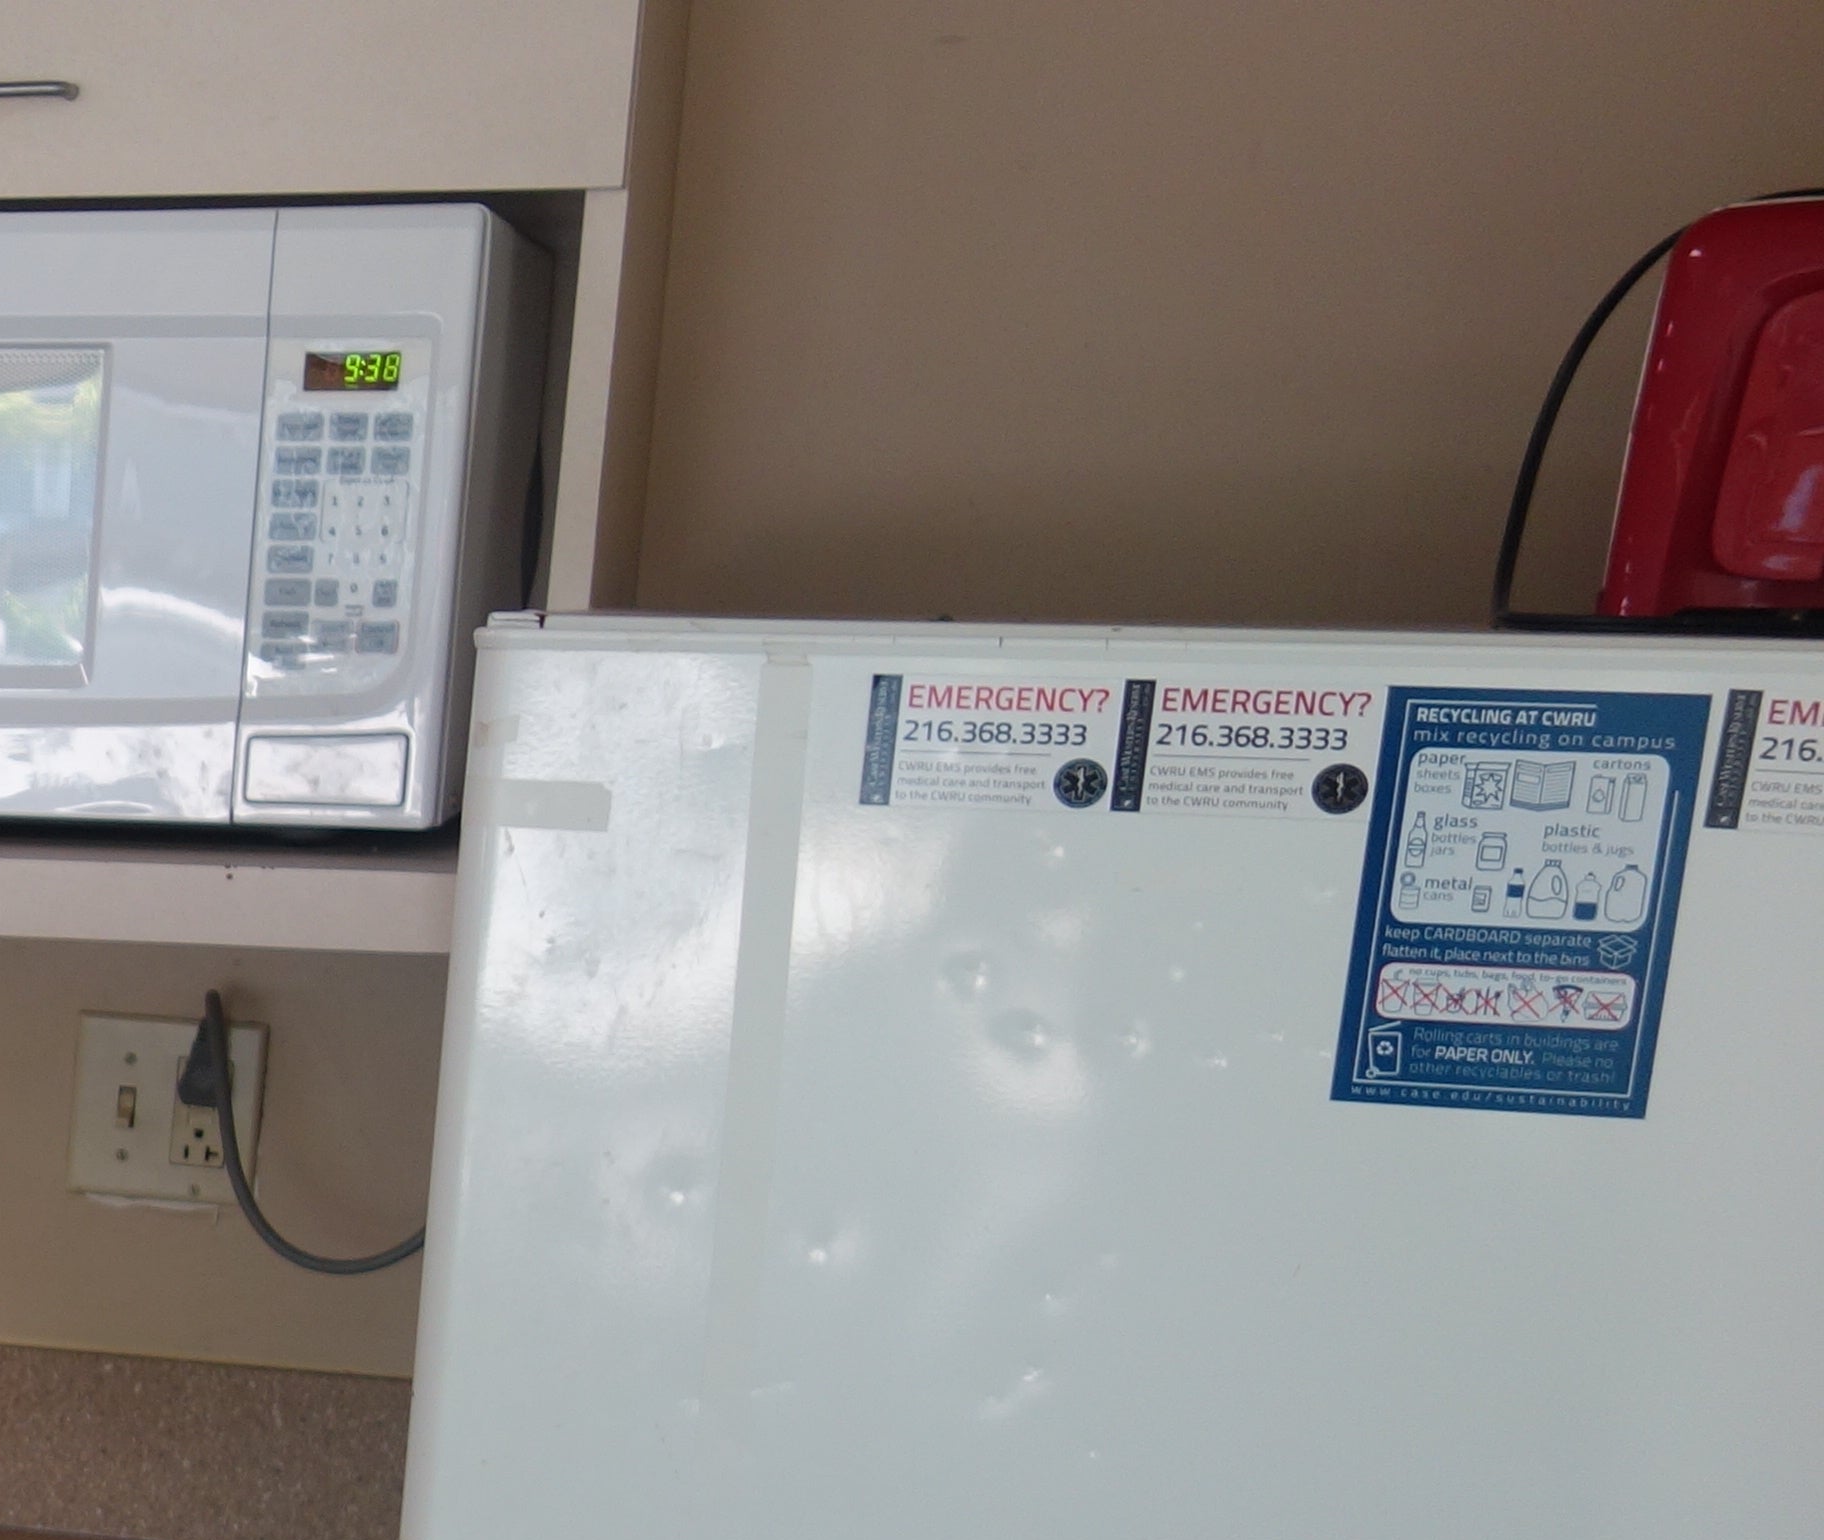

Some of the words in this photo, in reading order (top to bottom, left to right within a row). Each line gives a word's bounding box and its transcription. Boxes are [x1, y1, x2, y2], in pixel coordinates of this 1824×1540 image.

[344, 353, 400, 383] 9:38
[908, 685, 1110, 713] EMERGENCY?
[1161, 688, 1372, 716] EMERGENCY?
[1416, 707, 1512, 725] RECYCLING
[1516, 709, 1539, 725] AT
[1542, 710, 1597, 727] CWRU
[1768, 699, 1824, 727] EM
[903, 720, 1087, 746] 216.368.3333
[1156, 723, 1348, 750] 216.368.3333
[1413, 727, 1449, 742] mix
[1457, 729, 1550, 748] recycling
[1558, 734, 1583, 746] on
[1591, 736, 1676, 750] campus
[1418, 752, 1466, 767] paper
[1593, 759, 1651, 771] cartons
[898, 761, 933, 771] CWRU
[936, 762, 961, 772] EMS
[964, 763, 1010, 775] provides
[1014, 764, 1036, 775] free
[1150, 766, 1186, 776] CWRU
[1189, 767, 1215, 777] EMS
[1218, 768, 1267, 781] provides
[1271, 770, 1294, 780] free
[1416, 769, 1461, 781] sheets
[897, 776, 939, 787] medical
[942, 778, 966, 788] care
[968, 778, 990, 788] and
[993, 779, 1045, 791] transport
[1148, 780, 1193, 791] medical
[1196, 784, 1219, 793] care
[1223, 783, 1245, 794] and
[1248, 785, 1303, 797] transport
[1414, 781, 1451, 794] boxes
[1751, 781, 1791, 793] CWRU
[1794, 783, 1823, 795] EMS
[895, 790, 906, 800] to
[909, 790, 928, 801] the
[931, 791, 966, 802] CWRU
[968, 793, 1032, 806] community
[1147, 796, 1158, 805] to
[1161, 795, 1180, 806] the
[1183, 796, 1220, 807] CWRU
[1222, 797, 1288, 811] community
[1748, 798, 1796, 809] medical
[1433, 813, 1478, 830] glass
[1746, 812, 1757, 822] to
[1762, 812, 1783, 823] the
[1431, 833, 1476, 845] bottles
[1543, 823, 1600, 839] plastic
[1429, 845, 1455, 858] jars
[1541, 840, 1588, 854] bottles
[1591, 843, 1602, 854] &
[1604, 844, 1634, 858] jugs
[1424, 877, 1473, 891] metal
[1423, 889, 1453, 901] cans
[1384, 926, 1420, 942] keep
[1424, 926, 1520, 944] CARDBOARD
[1524, 932, 1592, 949] separate
[1382, 944, 1427, 959] flatten
[1444, 947, 1481, 964] place
[1483, 951, 1514, 963] next
[1516, 951, 1532, 964] to
[1534, 951, 1557, 965] the
[1560, 953, 1590, 967] bins
[1414, 1027, 1463, 1045] Rolling
[1466, 1030, 1502, 1044] carts
[1506, 1031, 1520, 1044] in
[1524, 1033, 1590, 1051] buildings
[1593, 1039, 1619, 1050] are
[1411, 1045, 1432, 1058] for
[1434, 1046, 1488, 1063] PAPER
[1491, 1048, 1535, 1065] ONLY.
[1541, 1050, 1591, 1067] Please
[1594, 1057, 1614, 1068] no
[1409, 1060, 1450, 1075] other
[1455, 1062, 1541, 1081] recyclables
[1546, 1069, 1562, 1081] or
